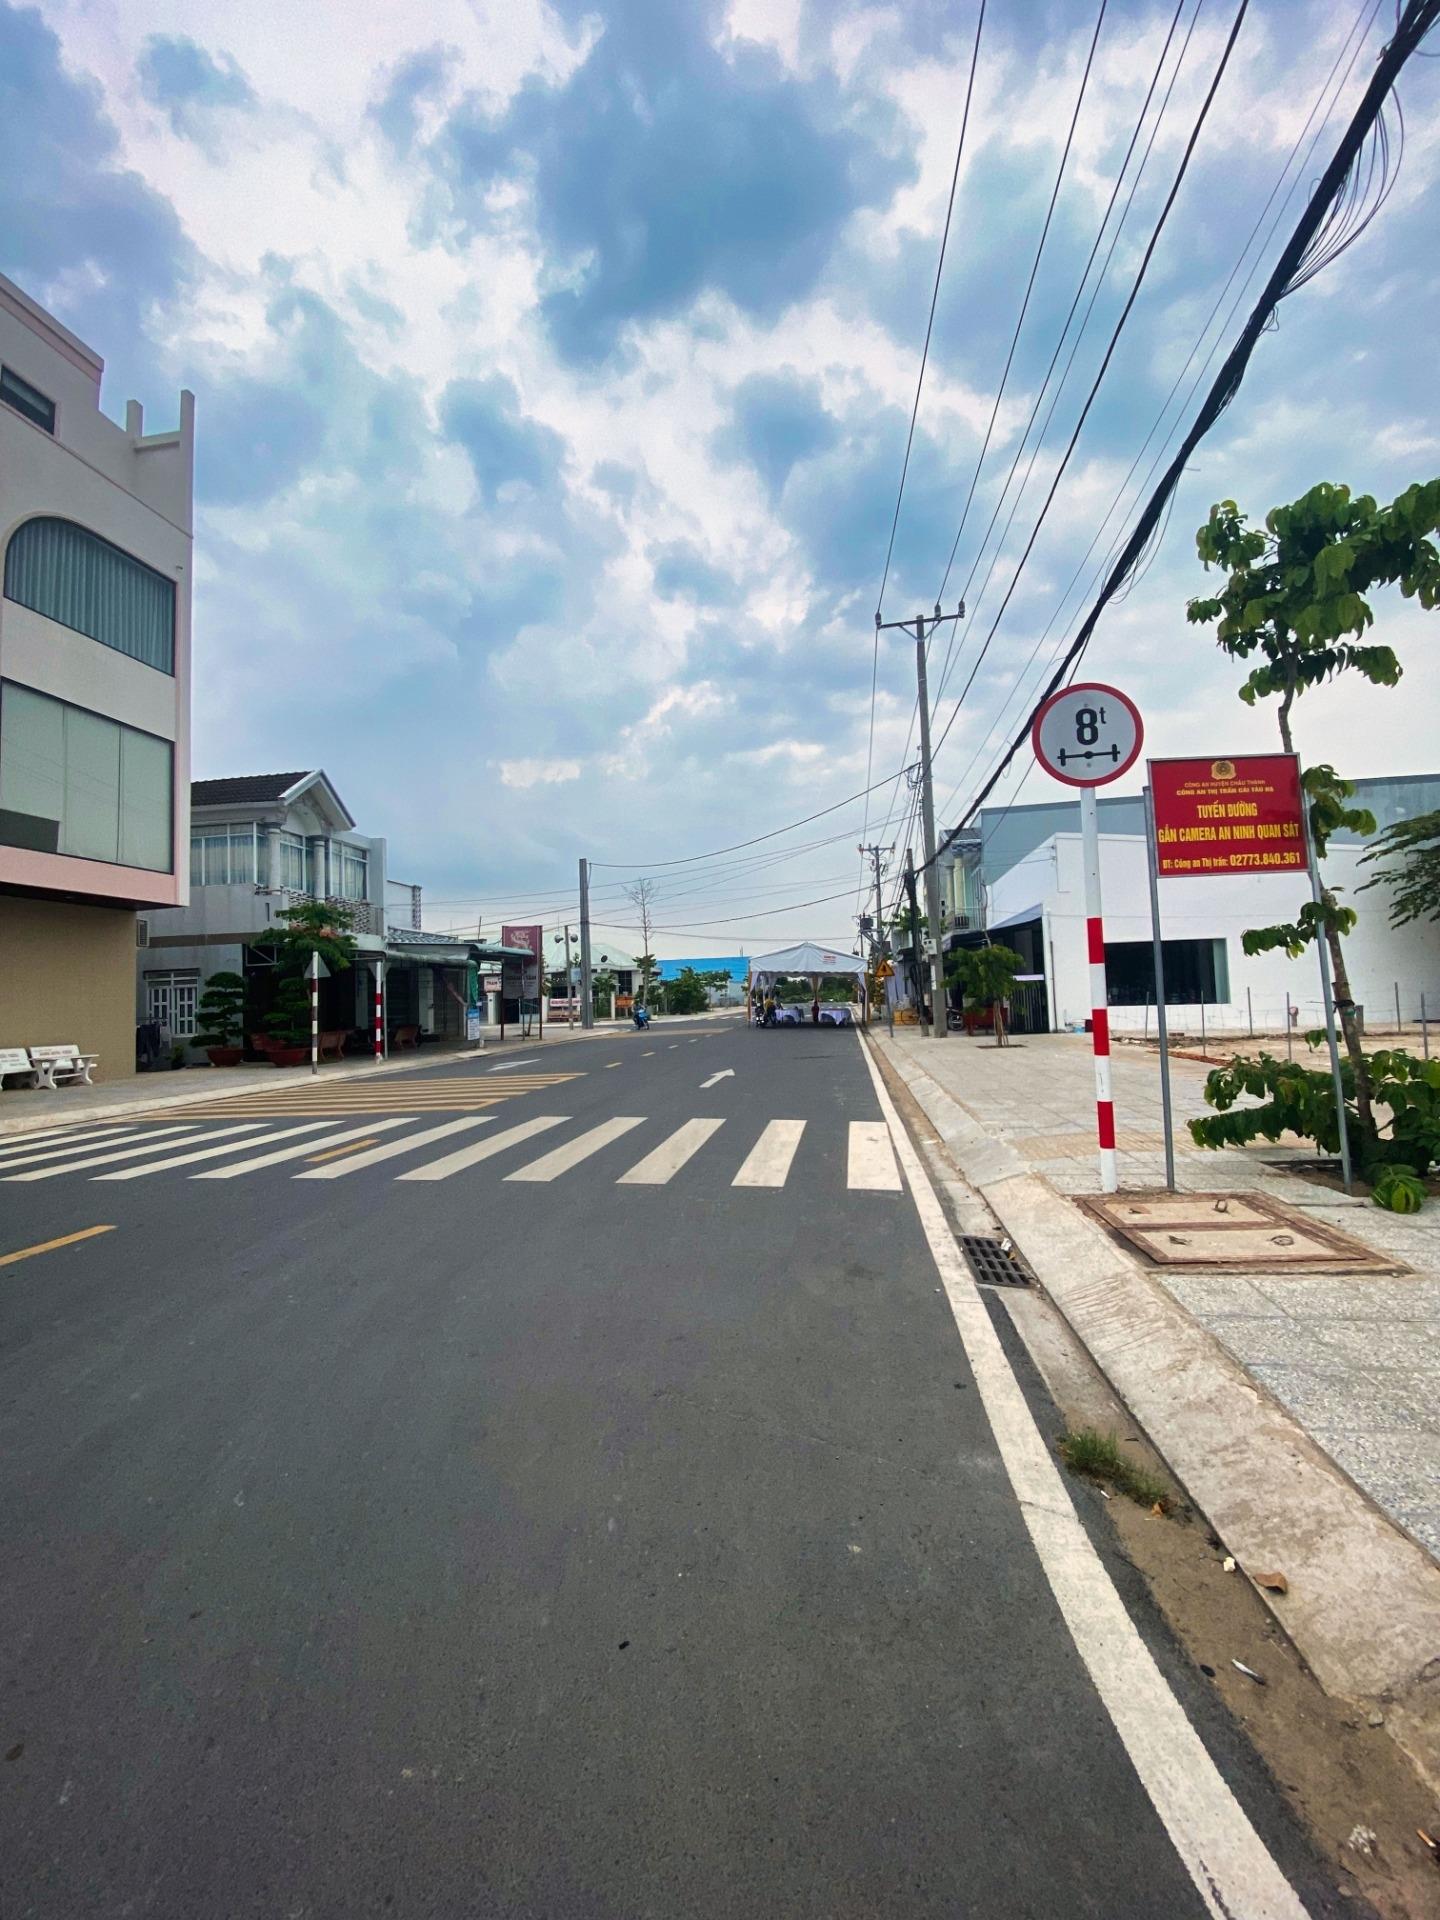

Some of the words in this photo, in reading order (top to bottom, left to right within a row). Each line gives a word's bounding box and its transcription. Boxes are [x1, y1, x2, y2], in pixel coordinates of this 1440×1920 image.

[1197, 800, 1226, 819] TUYẾN
[1227, 800, 1258, 817] ĐƯỜNG
[1158, 824, 1177, 843] GẮN
[1179, 826, 1217, 842] CAMERA
[1218, 826, 1231, 841] AN
[1232, 825, 1256, 840] NINH
[1257, 823, 1281, 840] QUAN
[1283, 820, 1299, 838] SÁT
[1174, 857, 1191, 870] Công
[1192, 859, 1201, 868] an
[1201, 857, 1212, 869] Thị
[1229, 852, 1301, 867] 02773.840.361
